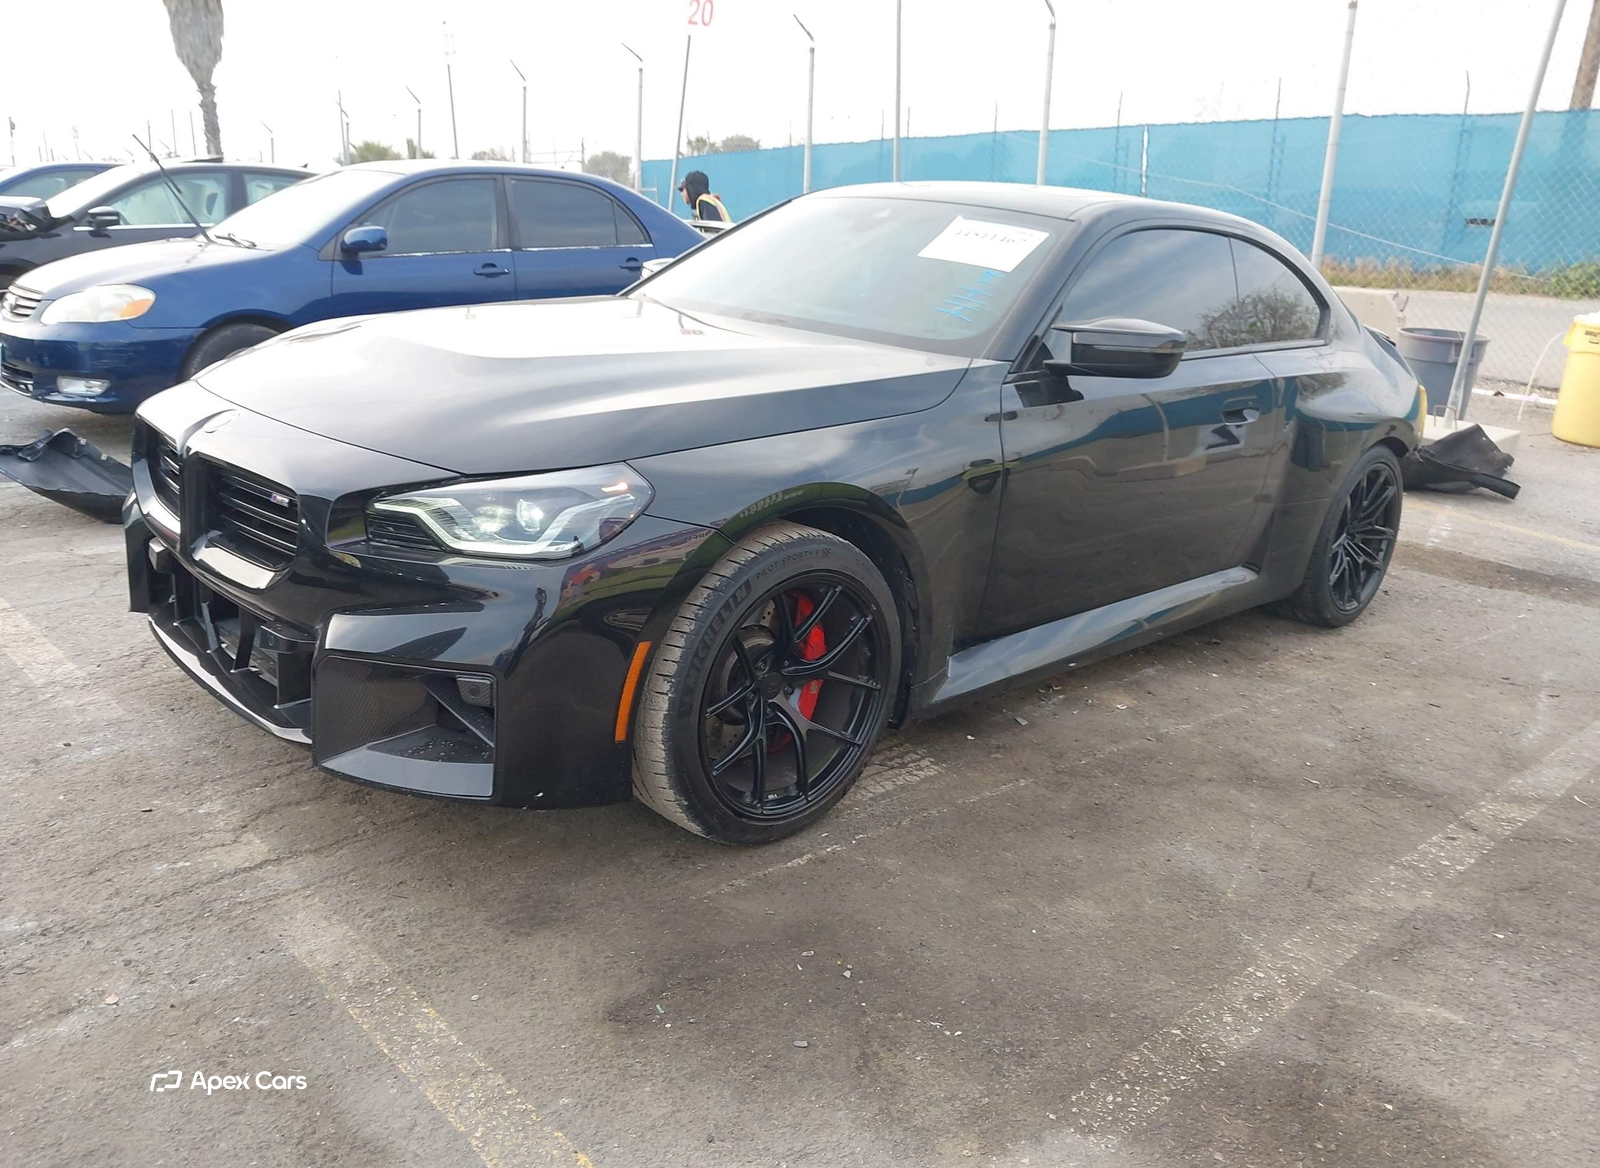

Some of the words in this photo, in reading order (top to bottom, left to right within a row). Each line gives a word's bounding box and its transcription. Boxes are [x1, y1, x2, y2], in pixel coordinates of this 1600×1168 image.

[687, 0, 714, 27] 20
[755, 561, 779, 580] PILOT
[781, 550, 809, 566] SPORT
